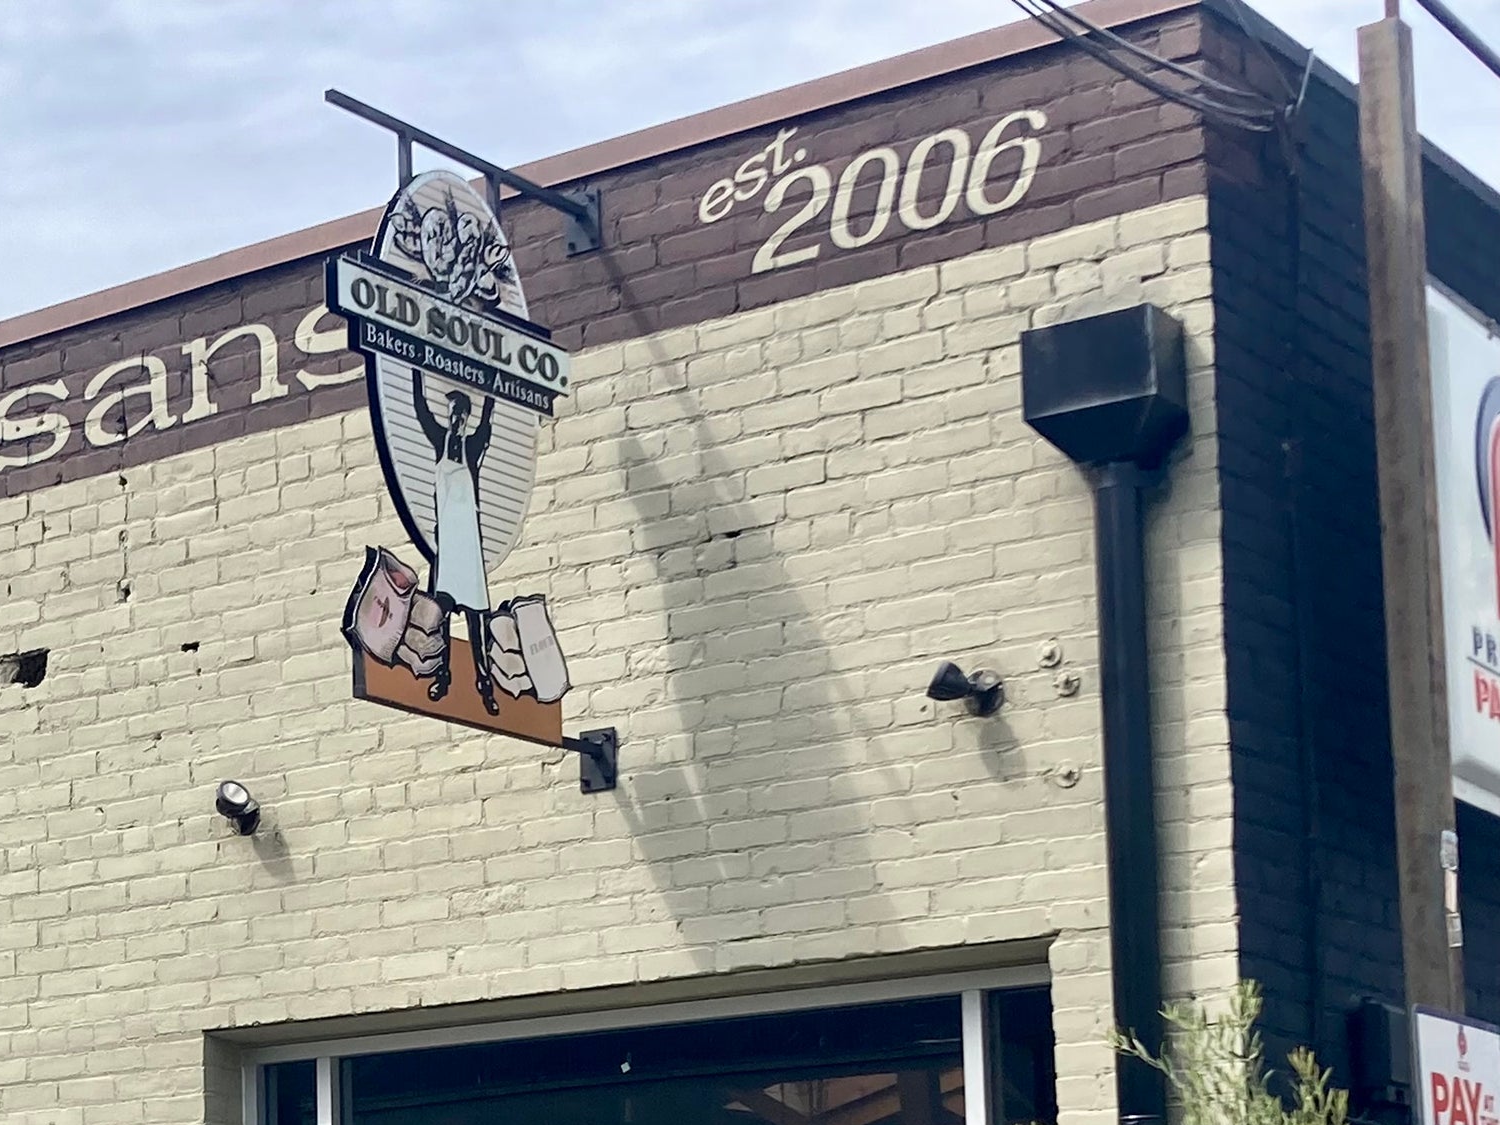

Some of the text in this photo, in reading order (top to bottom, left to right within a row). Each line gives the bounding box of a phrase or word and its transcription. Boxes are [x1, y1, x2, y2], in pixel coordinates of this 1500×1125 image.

[699, 109, 1047, 273] est. 2006
[350, 277, 568, 387] OLD SOUL CO.
[366, 324, 550, 409] Bakers Roasters Artisans
